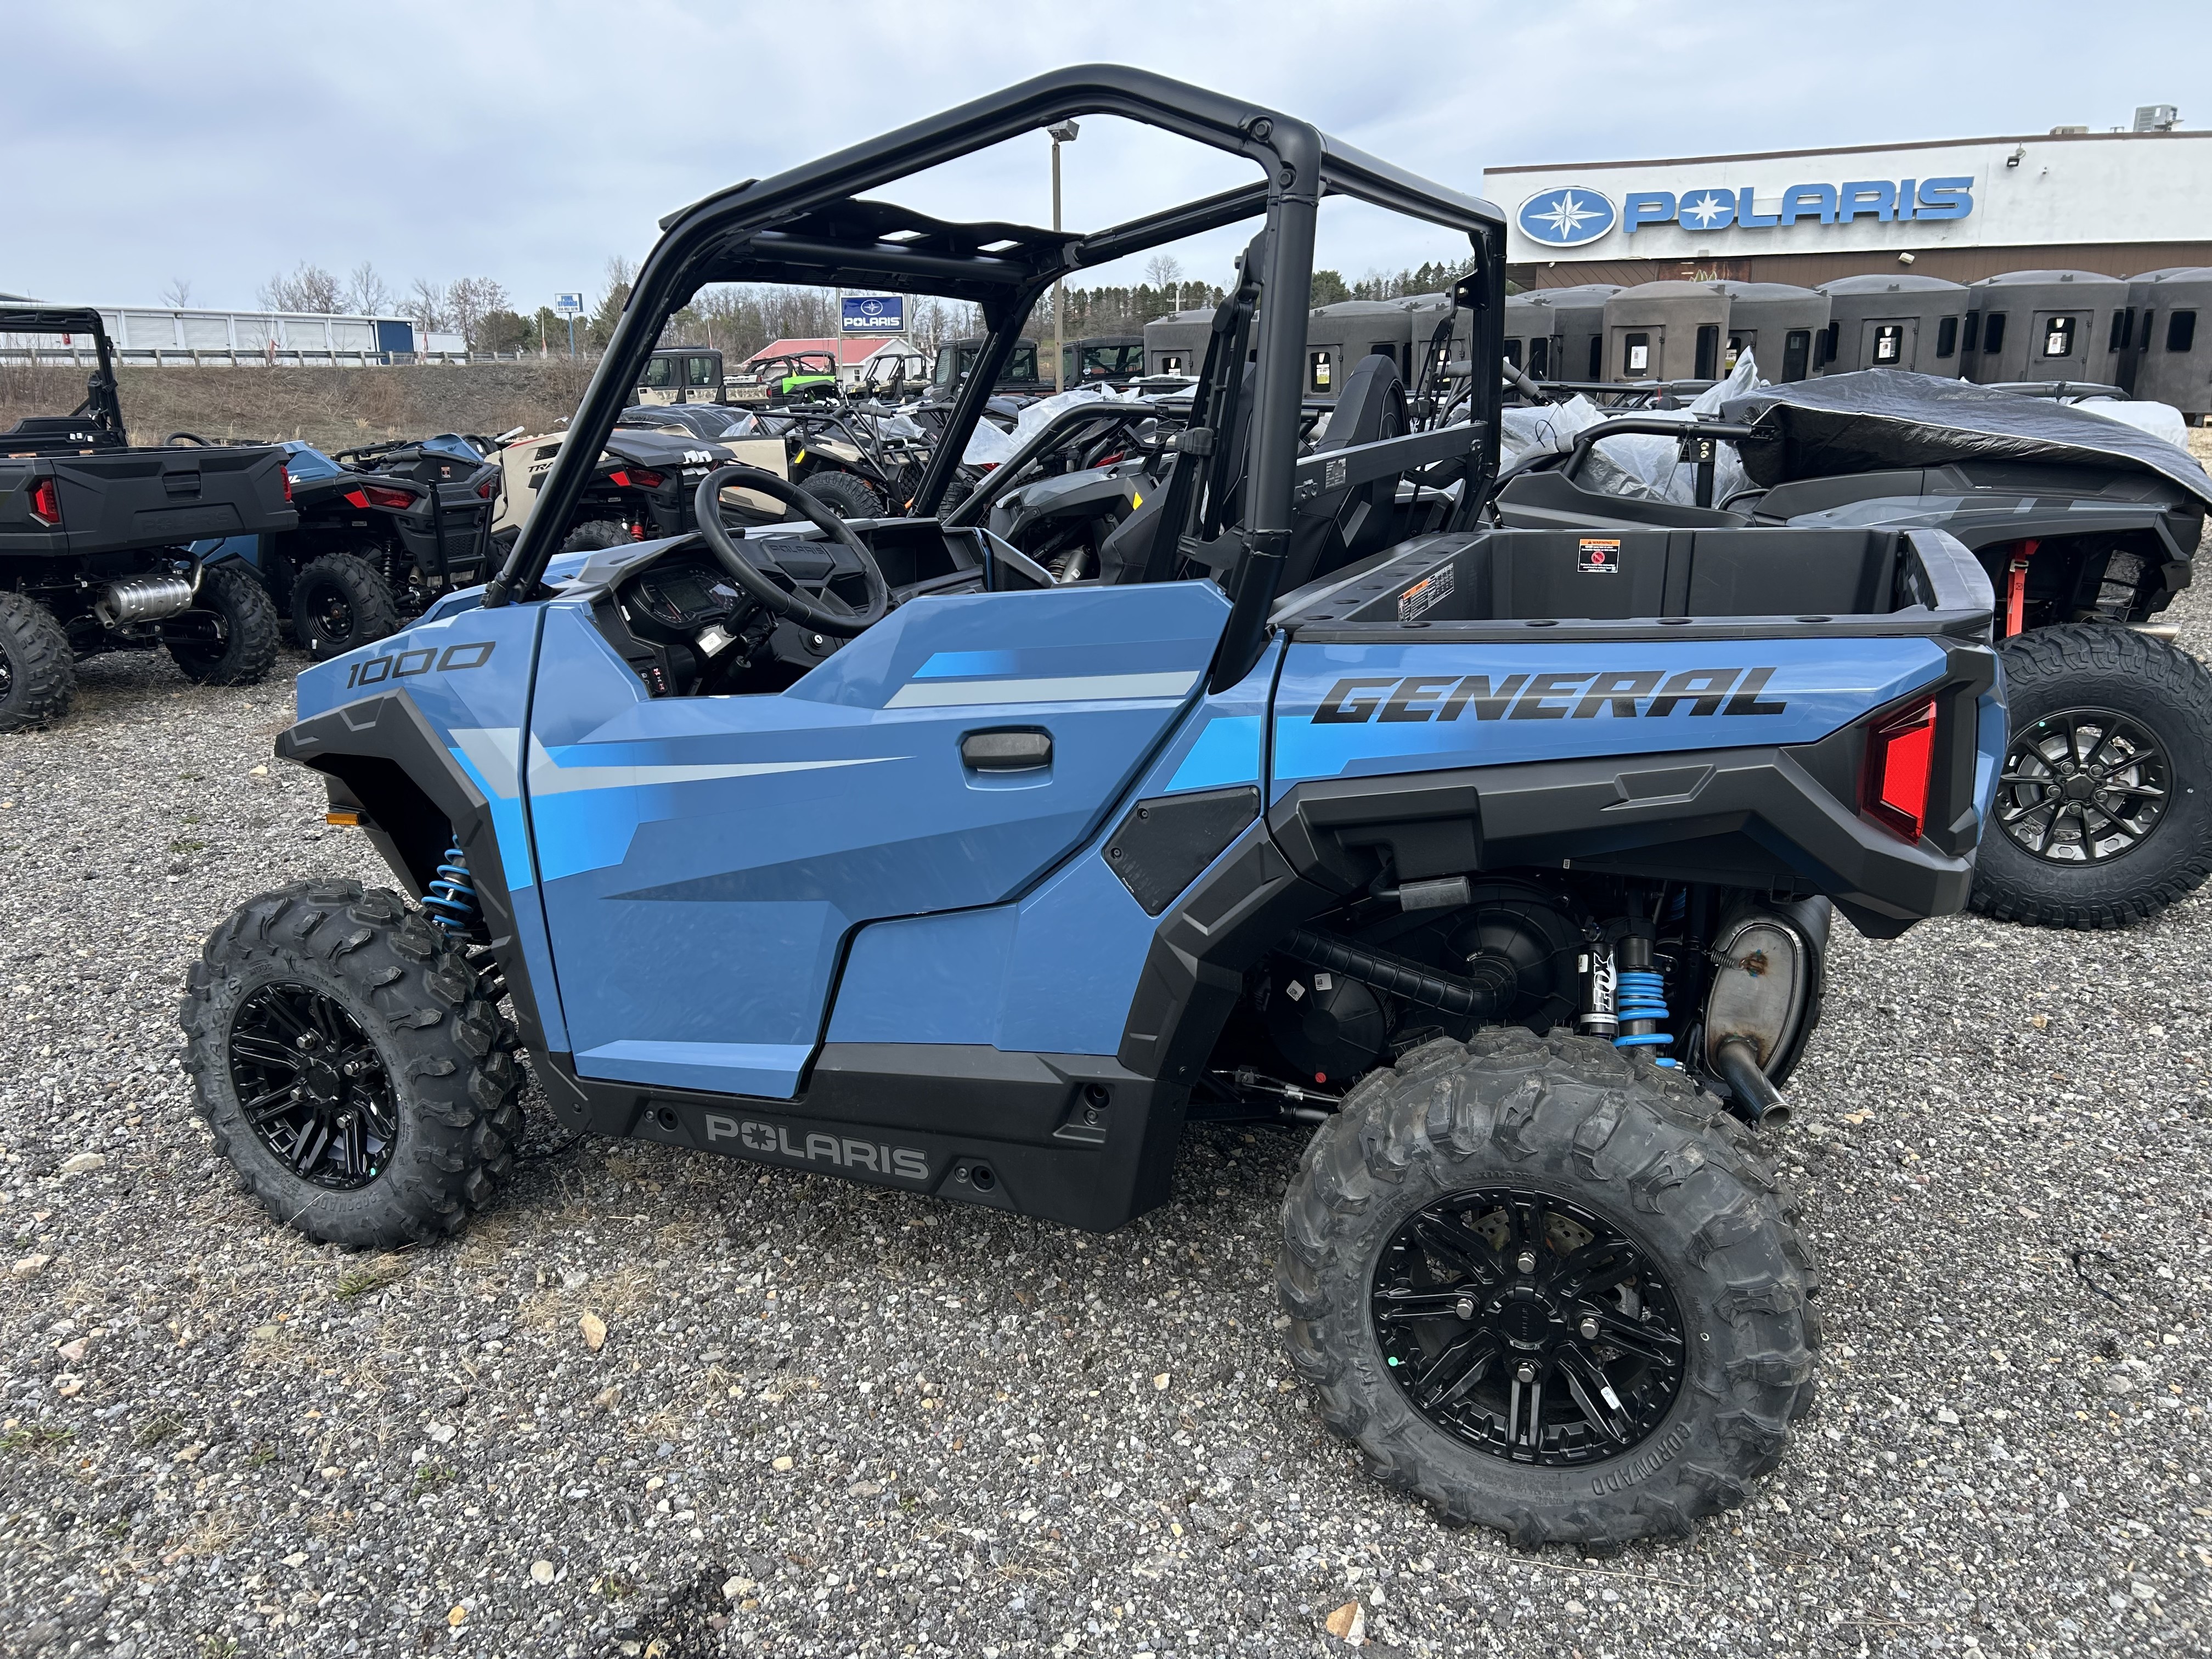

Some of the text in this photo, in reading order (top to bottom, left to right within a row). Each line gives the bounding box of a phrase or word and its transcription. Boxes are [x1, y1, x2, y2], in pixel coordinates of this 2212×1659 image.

[1623, 176, 1974, 233] POLARIS
[844, 317, 900, 326] POLARIS
[768, 545, 826, 555] POLARIS
[347, 641, 496, 689] 1000
[1310, 667, 1789, 724] GENERAL
[1593, 952, 1617, 1010] FOX
[706, 1114, 929, 1180] POLARIS
[1593, 1421, 1692, 1496] CORONADO
[1536, 1497, 1565, 1505] WARNING
